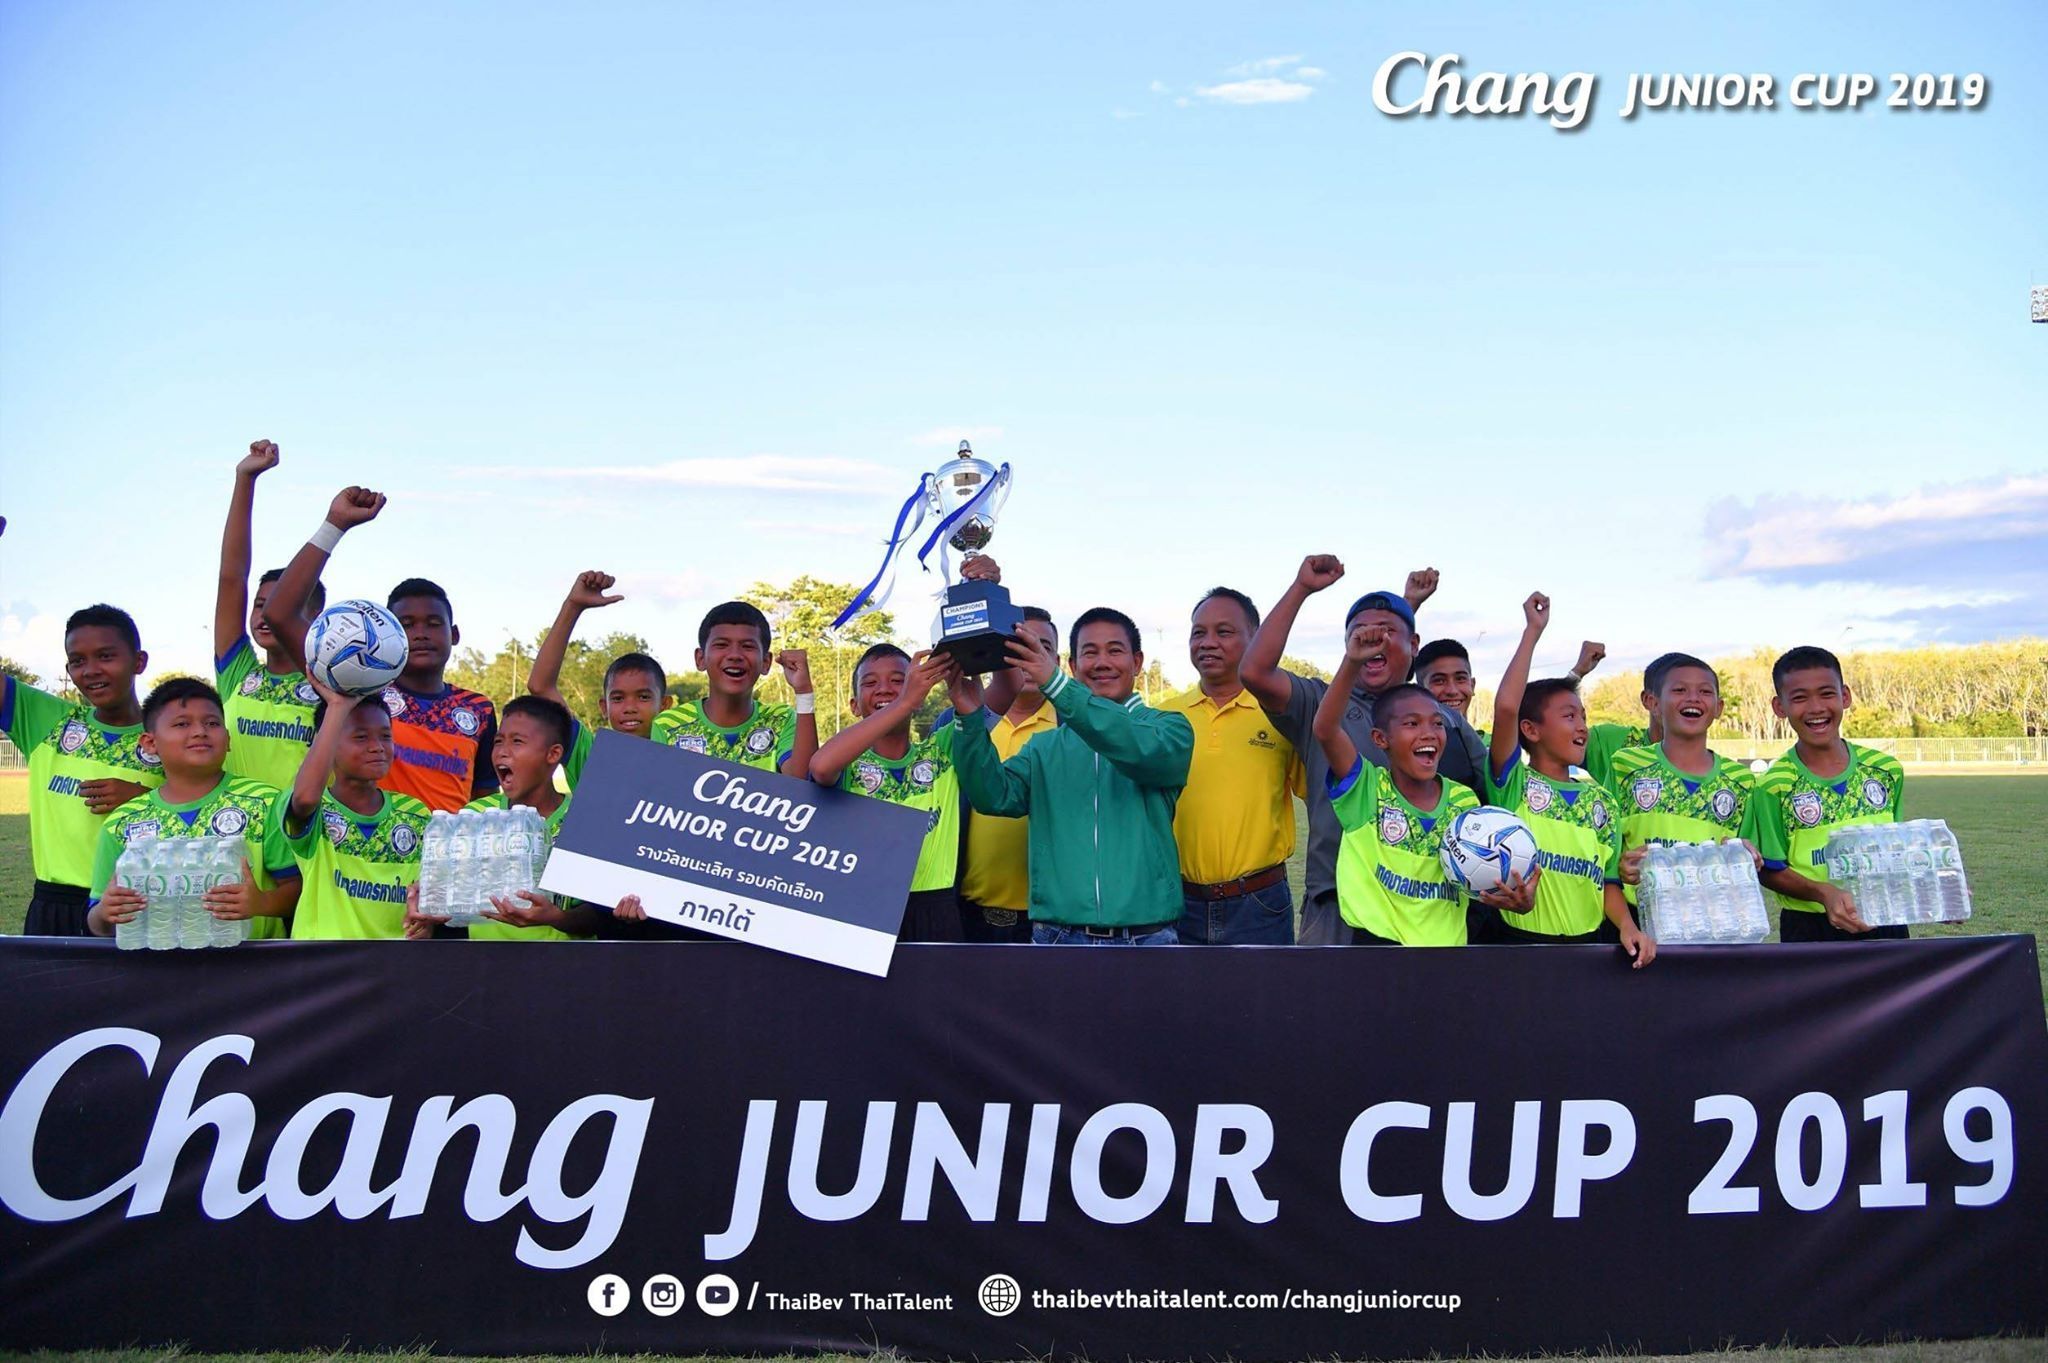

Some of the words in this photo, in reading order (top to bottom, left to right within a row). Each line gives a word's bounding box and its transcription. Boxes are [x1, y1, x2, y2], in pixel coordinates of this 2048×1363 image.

[345, 600, 386, 627] molten
[945, 602, 985, 615] CHAMPIONS
[693, 769, 817, 833] Chang
[625, 800, 727, 841] JUNIOR
[733, 826, 790, 856] CUP
[791, 842, 859, 875] 2019
[635, 844, 735, 880] รางวัลชนะเลิศ
[736, 871, 825, 903] รอบคัดเลือก
[678, 900, 756, 933] ภาคใต้
[0, 1027, 656, 1271] Chang
[704, 1100, 1281, 1261] JUNIOR
[1340, 1099, 1638, 1223] CUP
[1687, 1086, 2015, 1215] 2019
[765, 1292, 844, 1310] ThaiBev
[849, 1292, 953, 1310] ThaiTalent
